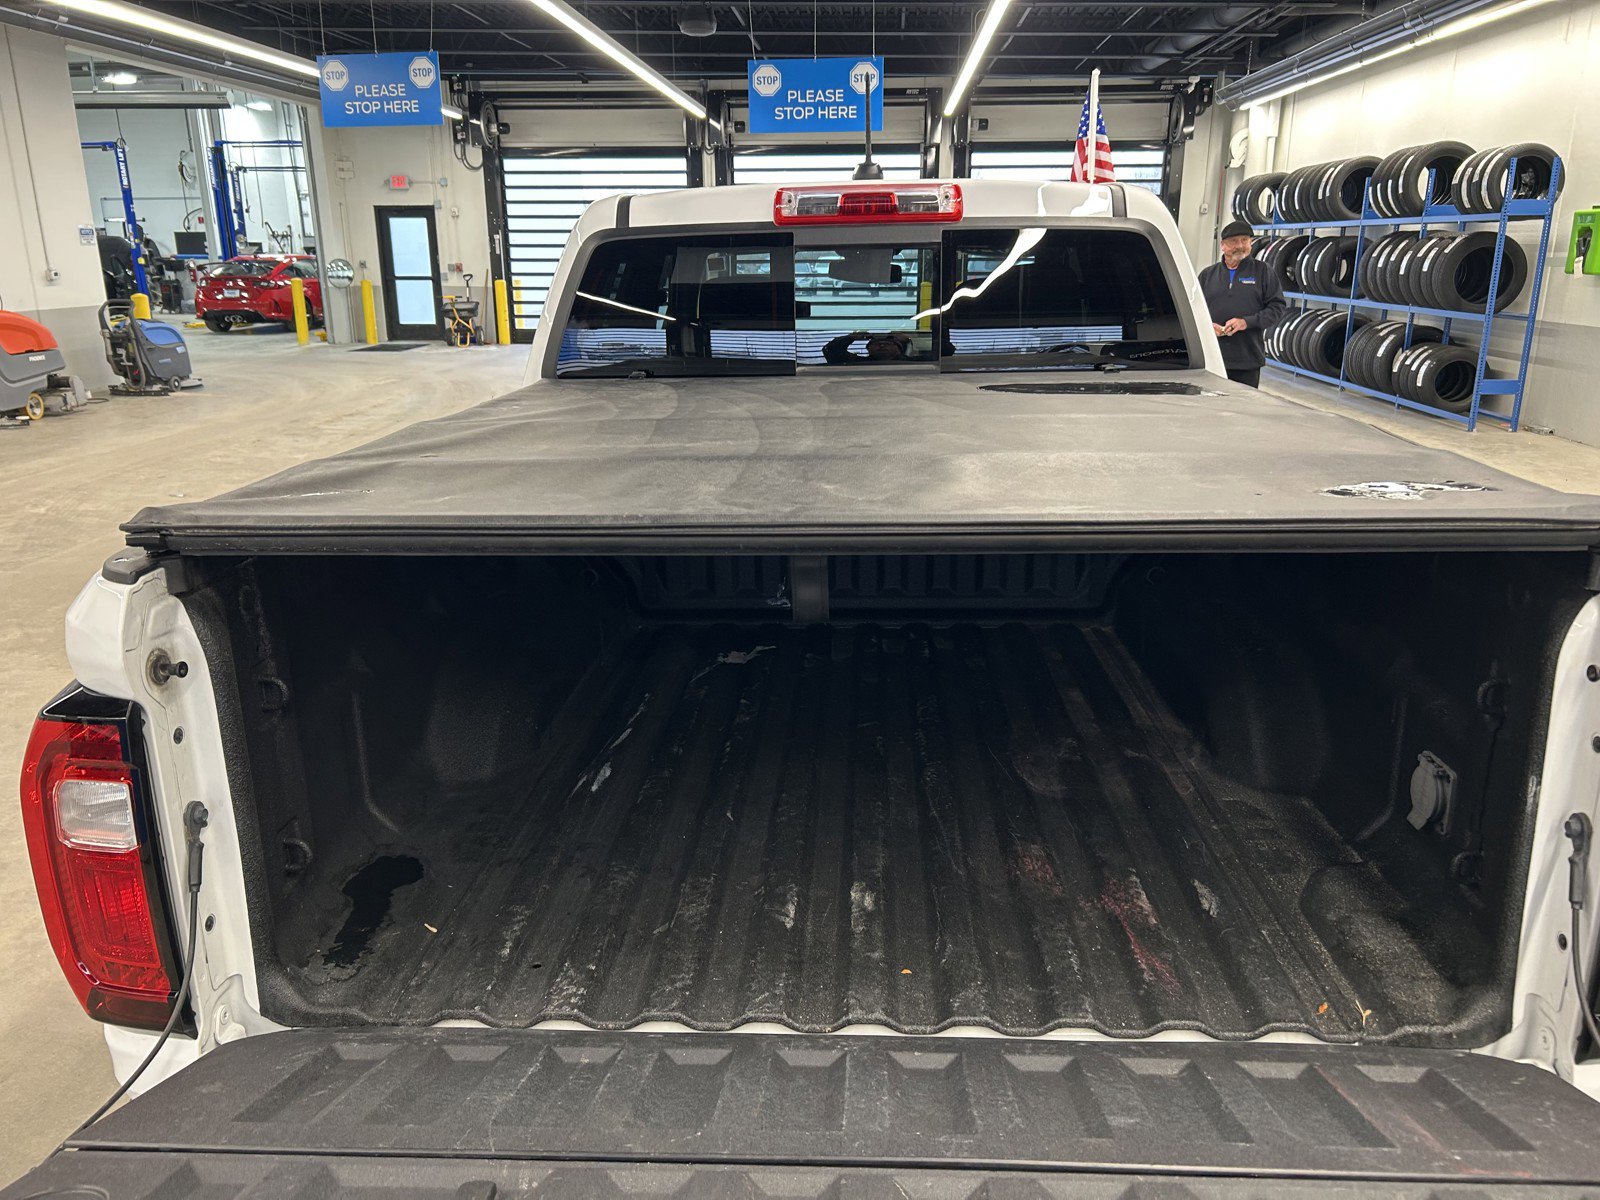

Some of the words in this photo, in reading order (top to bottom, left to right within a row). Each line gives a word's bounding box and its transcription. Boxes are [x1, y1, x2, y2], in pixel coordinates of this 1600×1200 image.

[326, 72, 346, 80] STOP
[412, 68, 432, 78] STOP
[756, 76, 778, 86] STOP
[354, 84, 406, 98] PLEASE
[787, 89, 844, 103] PLEASE
[344, 101, 381, 115] STOP
[384, 100, 420, 113] HERE
[774, 106, 815, 120] STOP
[818, 105, 858, 119] HERE
